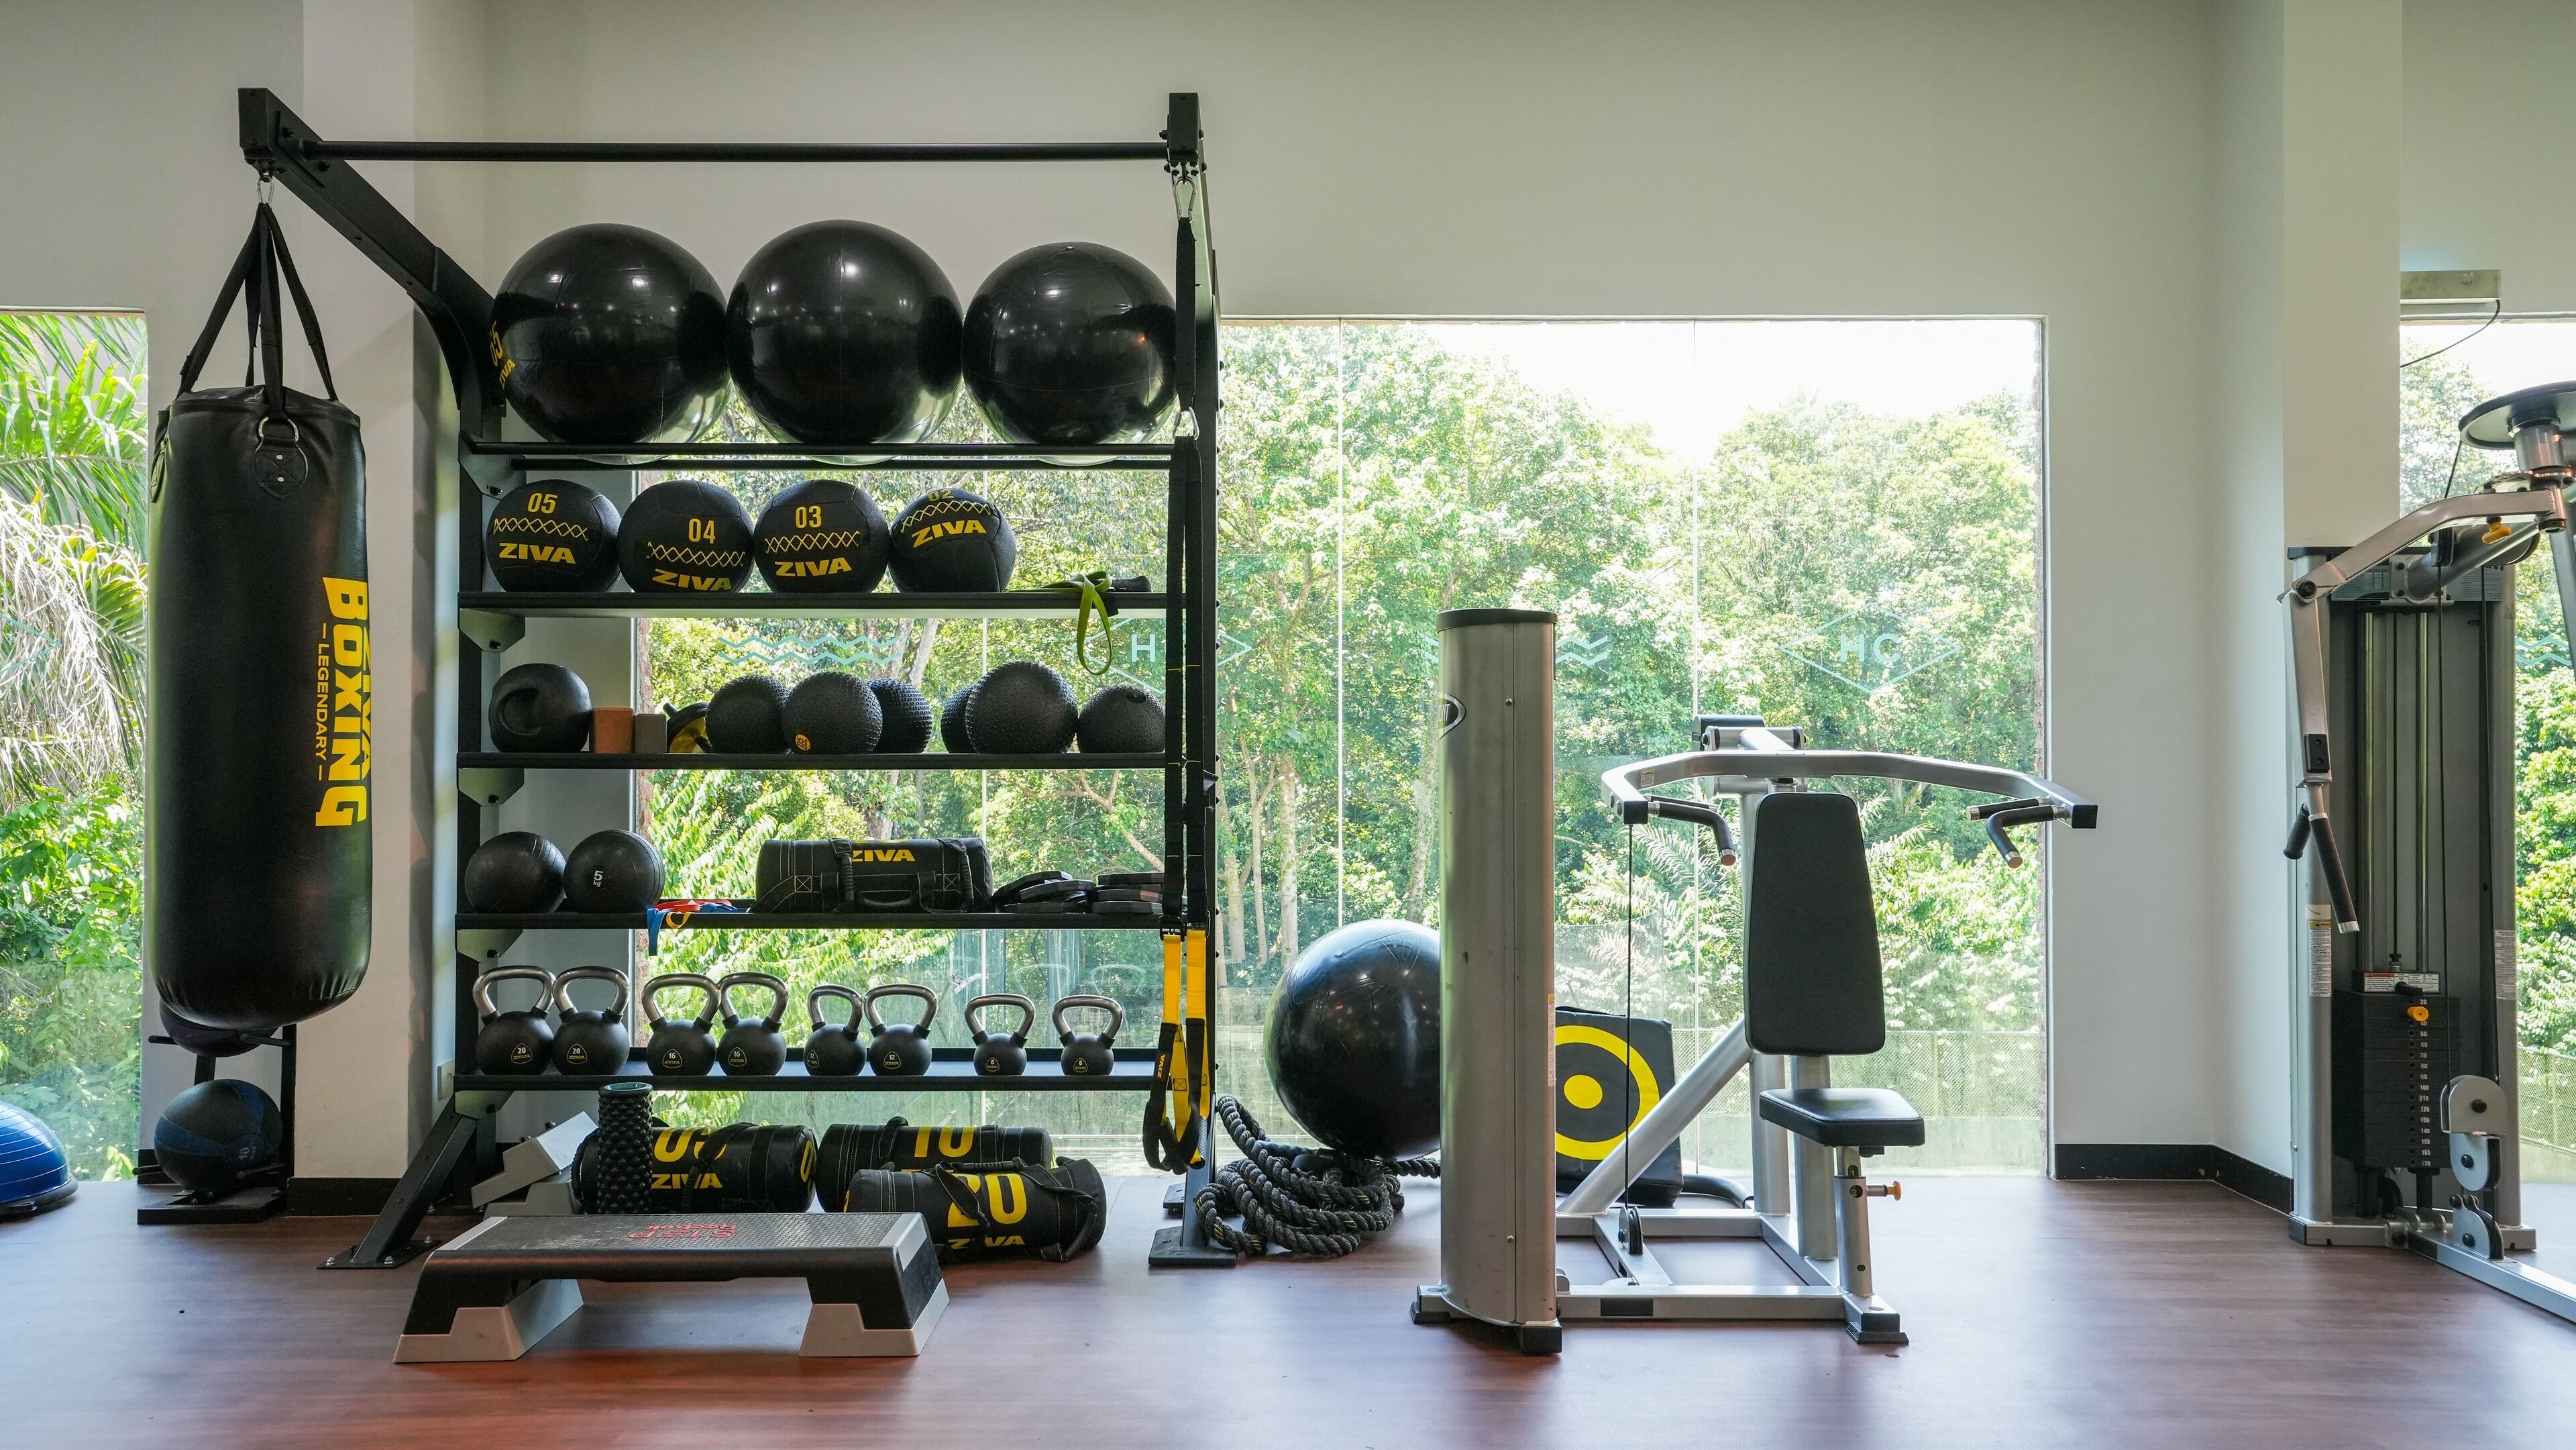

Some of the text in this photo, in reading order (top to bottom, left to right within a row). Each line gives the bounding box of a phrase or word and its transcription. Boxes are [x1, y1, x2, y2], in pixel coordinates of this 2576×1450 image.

[527, 493, 558, 514] 05
[795, 505, 822, 529] 03
[688, 518, 716, 544] 04
[911, 519, 987, 548] ZIVA
[499, 542, 576, 564] ZIVA
[774, 557, 853, 577] ZIVA
[652, 568, 731, 591] ZIVA
[1840, 633, 1902, 663] HC
[315, 577, 368, 827] BOXING
[315, 643, 330, 762] LEGENDARY
[851, 849, 916, 863] ZIVA
[592, 879, 602, 888] kg
[593, 870, 604, 881] 5
[1157, 1054, 1167, 1079] ZIVA
[628, 1230, 737, 1240] STEP
[947, 1235, 1026, 1250] ZVA
